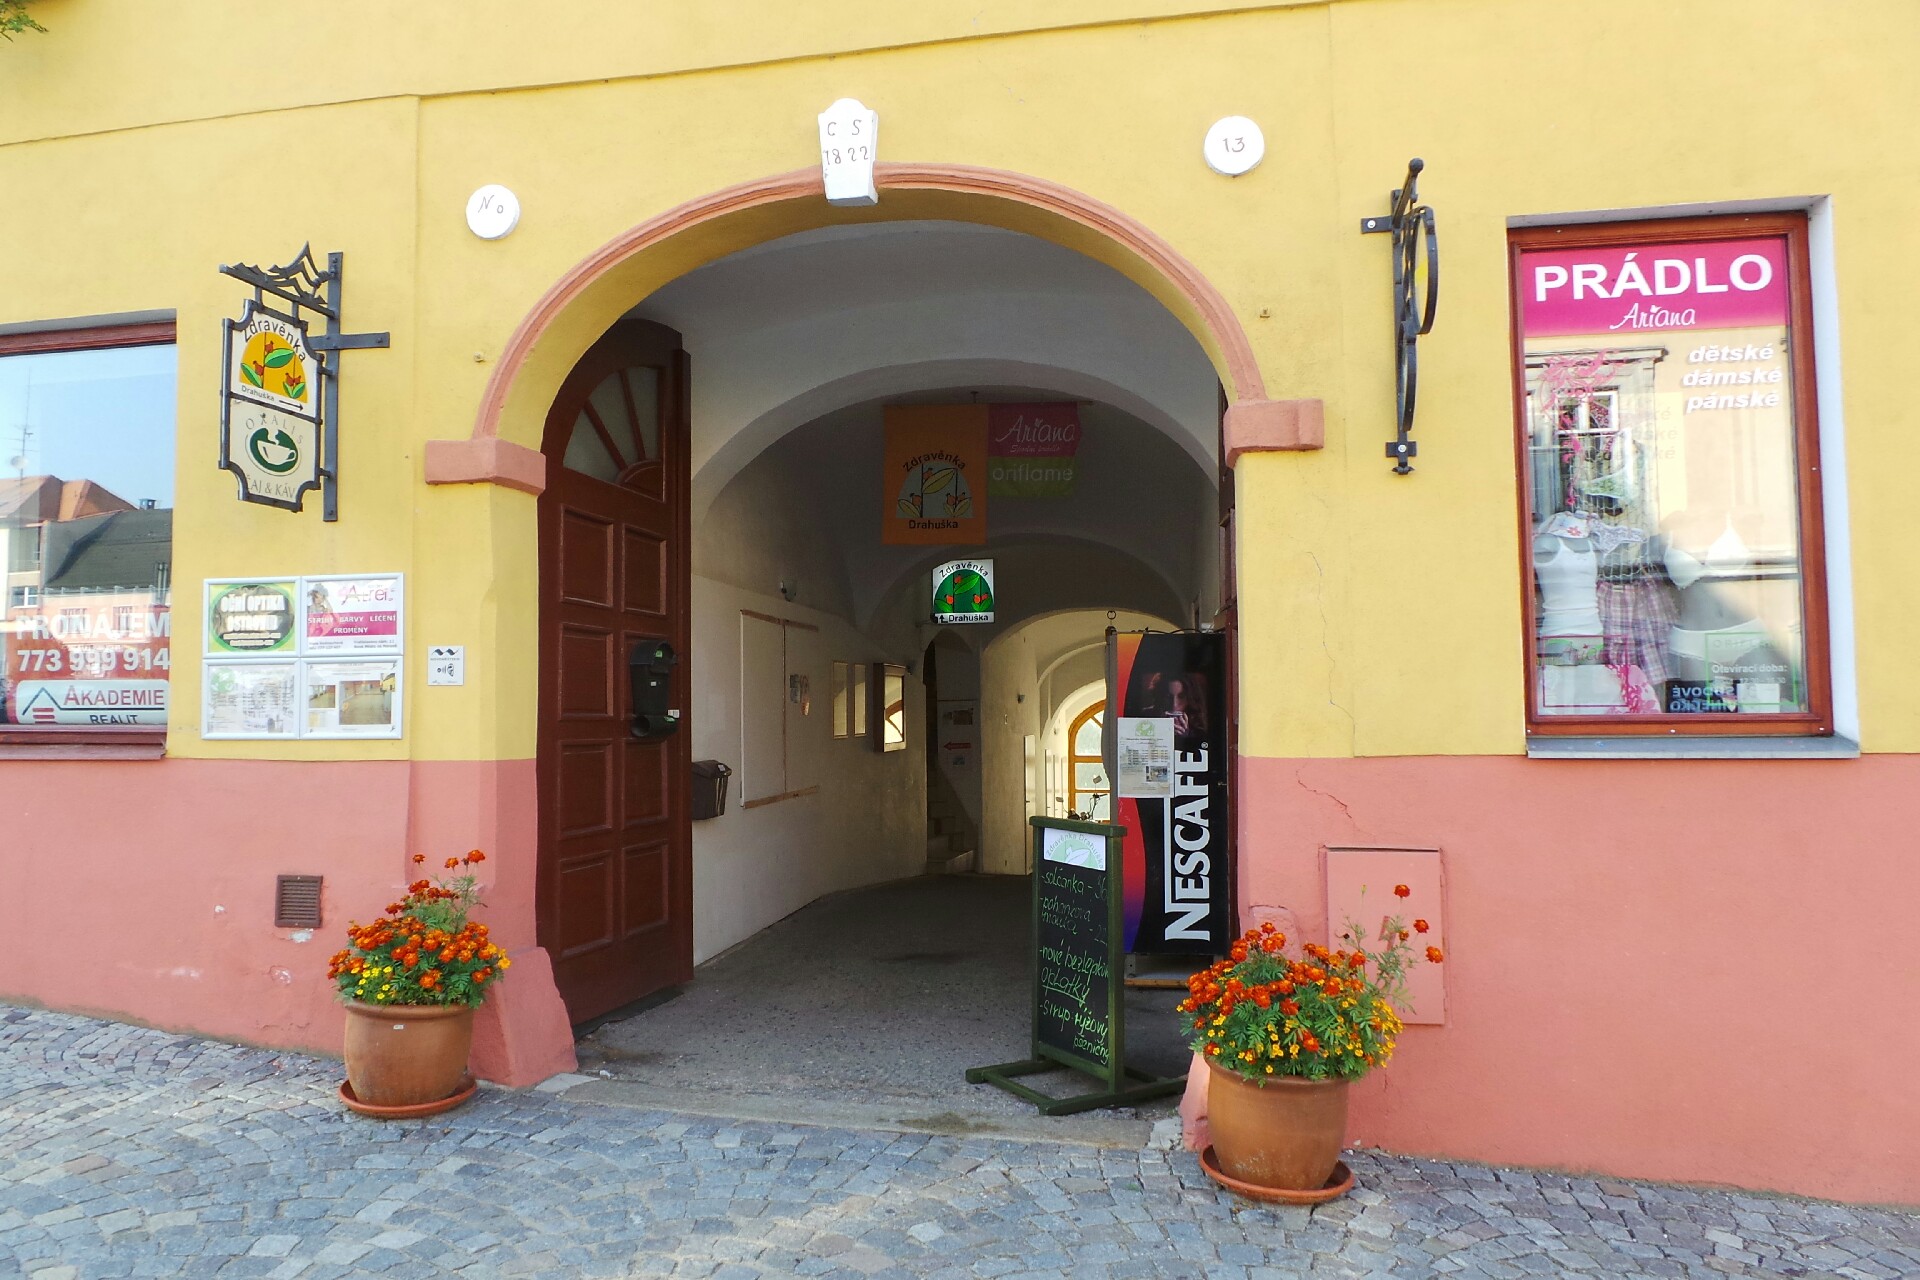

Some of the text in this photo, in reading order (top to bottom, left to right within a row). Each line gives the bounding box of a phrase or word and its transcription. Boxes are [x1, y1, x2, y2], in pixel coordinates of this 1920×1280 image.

[827, 119, 862, 136] C S
[1222, 136, 1245, 153] 13
[823, 146, 868, 165] 1822
[1534, 252, 1773, 302] PRÁDLO
[1609, 303, 1696, 330] Ariana
[243, 319, 306, 362] Zdravěnka
[1688, 342, 1774, 363] dětské
[1682, 367, 1783, 388] dámské
[241, 385, 275, 402] Drahuška
[1686, 390, 1781, 414] pánské
[995, 414, 1076, 443] Ariana
[902, 450, 967, 473] Zdravěnka
[992, 463, 1073, 483] oriflame
[264, 486, 272, 494] &
[275, 483, 296, 499] KÁV
[908, 519, 959, 530] Drahuška
[939, 561, 989, 578] Zdravěnka
[15, 608, 170, 640] PRONÁJEM
[948, 614, 989, 623] Drahuška
[18, 647, 171, 673] 773 999 914
[64, 685, 165, 706] AKADEMIE
